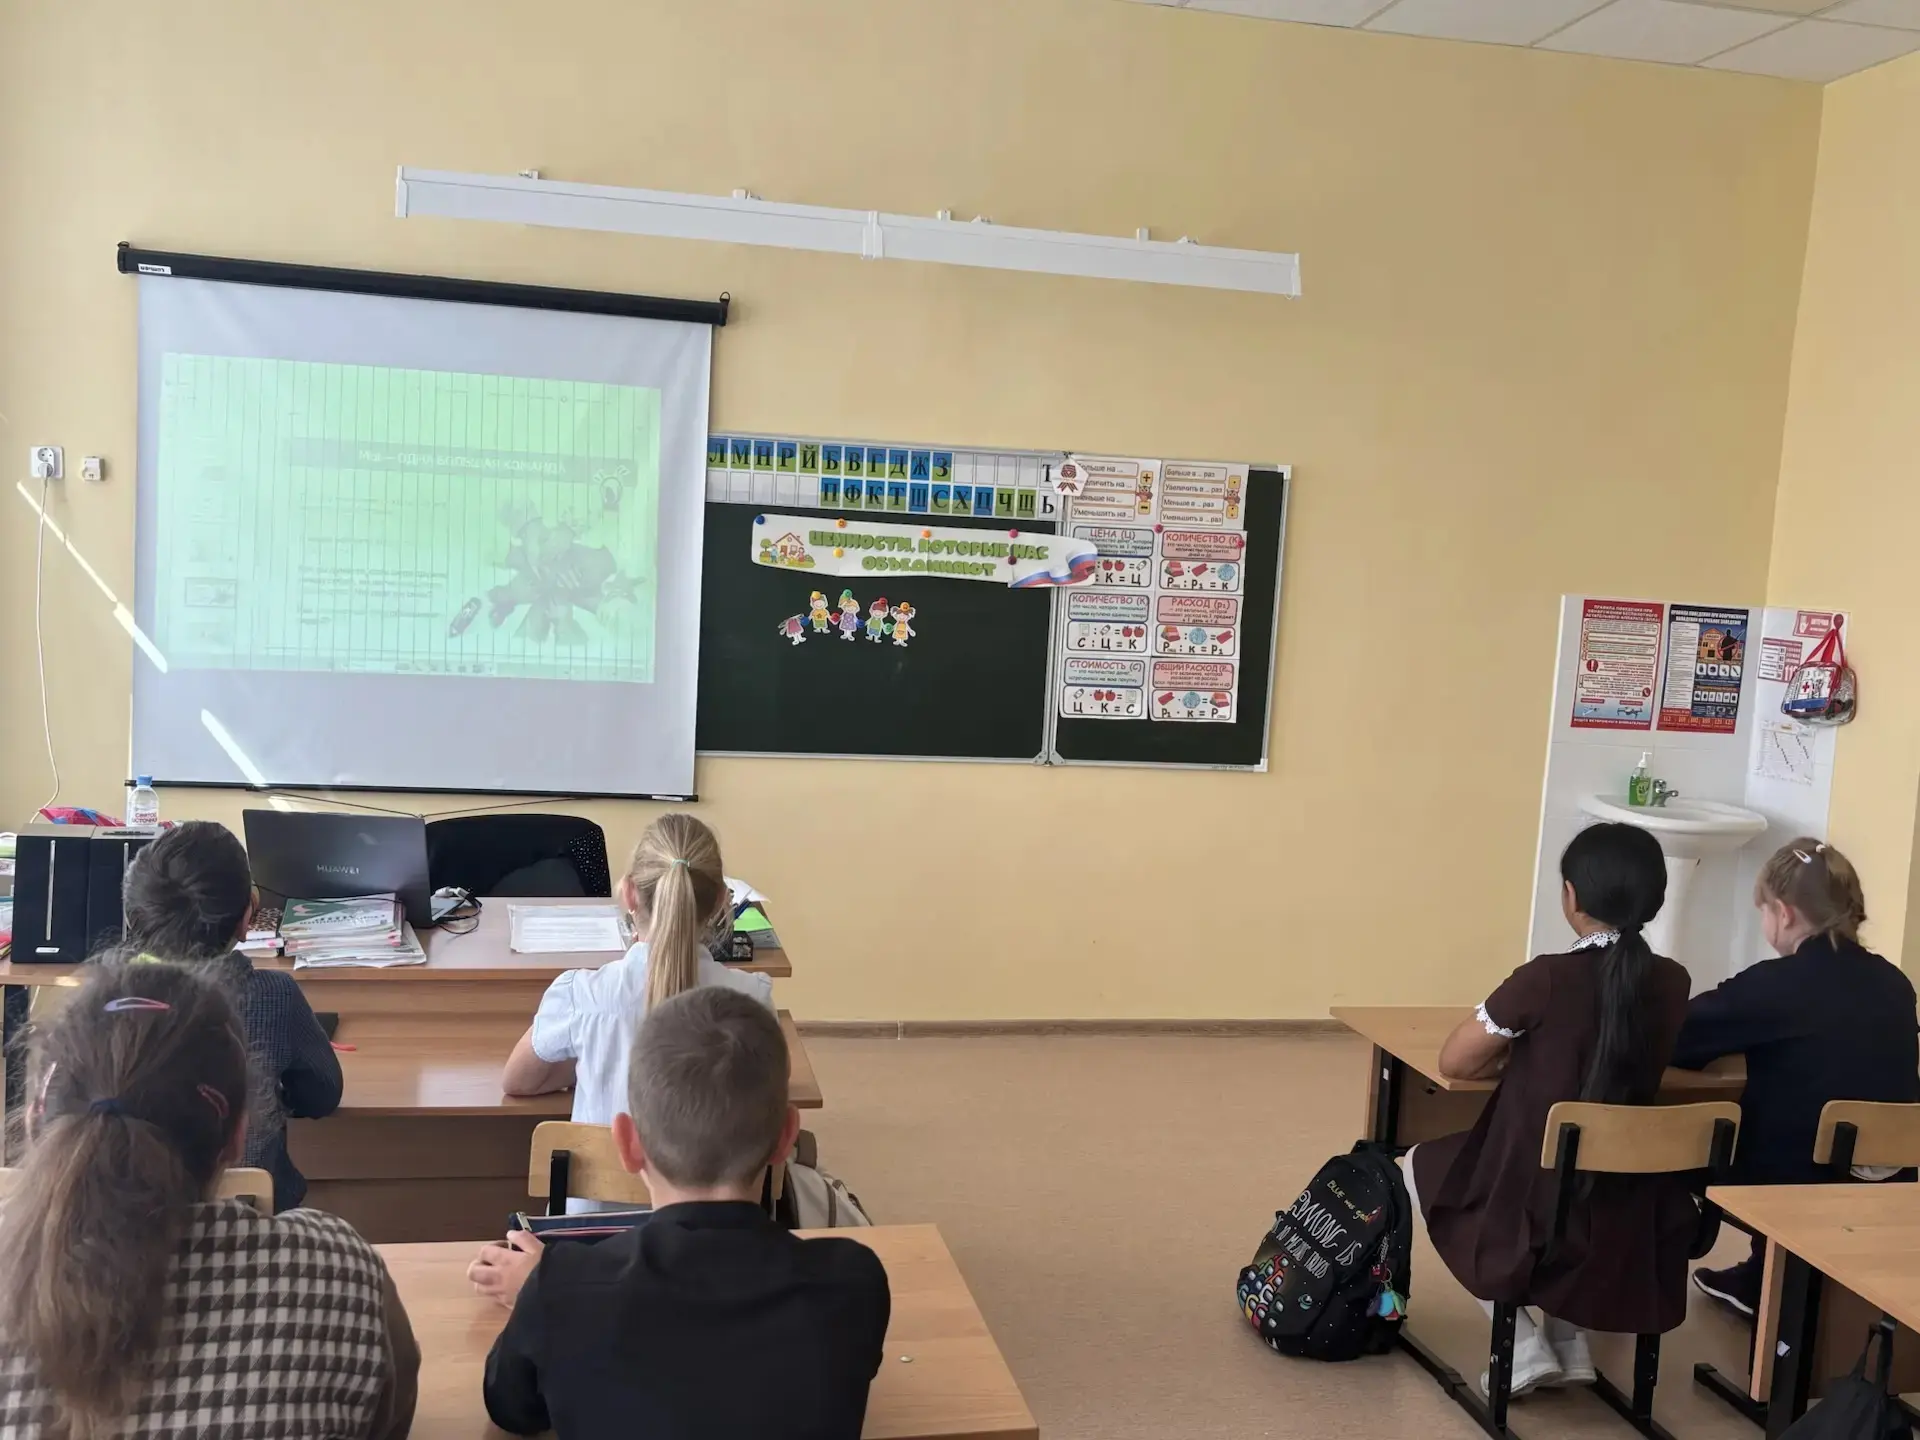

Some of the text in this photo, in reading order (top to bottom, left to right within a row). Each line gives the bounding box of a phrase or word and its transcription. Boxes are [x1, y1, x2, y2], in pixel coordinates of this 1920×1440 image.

[709, 444, 725, 463] Л
[732, 445, 749, 464] М
[756, 446, 772, 466] Н
[780, 448, 794, 467] Р
[802, 443, 816, 469] Й
[825, 451, 839, 470] Б
[848, 452, 861, 472] В
[870, 453, 883, 473] Г
[889, 455, 905, 477] Д
[912, 455, 929, 476] Ж
[936, 457, 949, 477] З
[1079, 464, 1105, 472] ольше
[824, 482, 1055, 514] П Ф К Т Ш С Х Ц Ч Щ Ь
[1074, 508, 1116, 517] Уменьшить
[1090, 529, 1136, 540] ЦЕНА (Ц)
[1166, 533, 1225, 543] КОЛИЧЕСТВО
[809, 531, 1049, 560] ЦЕННОСТИ, КОТОРЫЕ НАС
[862, 556, 997, 576] ОБЪЕДИНЯЮТ
[1105, 572, 1141, 585] К Ц
[1072, 595, 1133, 604] КОЛИЧЕСТВО
[1172, 597, 1210, 608] РАСХОД
[1077, 637, 1136, 650] С Ц К
[1070, 661, 1141, 672] СТОИМОСТЬ (С)
[1155, 663, 1217, 672] ОБЩИЙ РАСХОД
[1074, 702, 1134, 714] Ц К С
[317, 864, 359, 874] HUAWEI
[1327, 1180, 1345, 1198] BLUE
[1291, 1190, 1362, 1266] AMONG US
